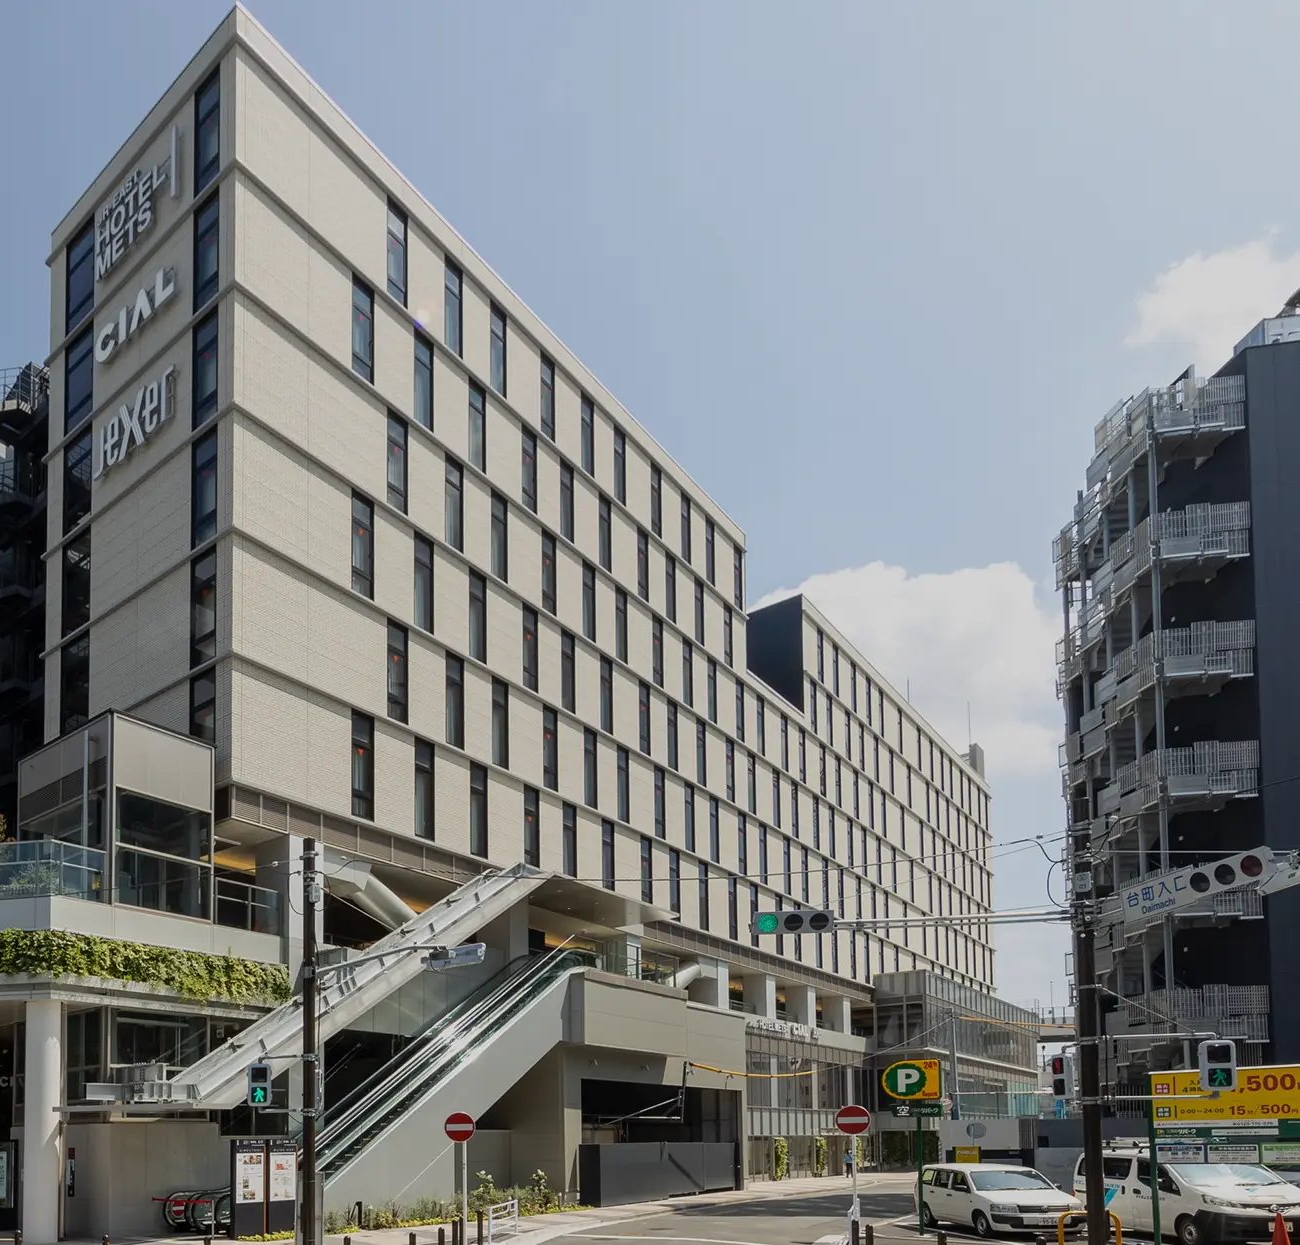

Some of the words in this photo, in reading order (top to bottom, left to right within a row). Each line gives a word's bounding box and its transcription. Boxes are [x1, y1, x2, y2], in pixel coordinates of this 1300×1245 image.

[96, 164, 167, 250] HOTEL
[96, 200, 152, 282] METS
[95, 266, 176, 364] CIAL
[1126, 875, 1187, 908] 台町入口
[1142, 897, 1176, 914] Daimachi
[897, 1069, 920, 1093] P
[896, 1106, 910, 1116] 空
